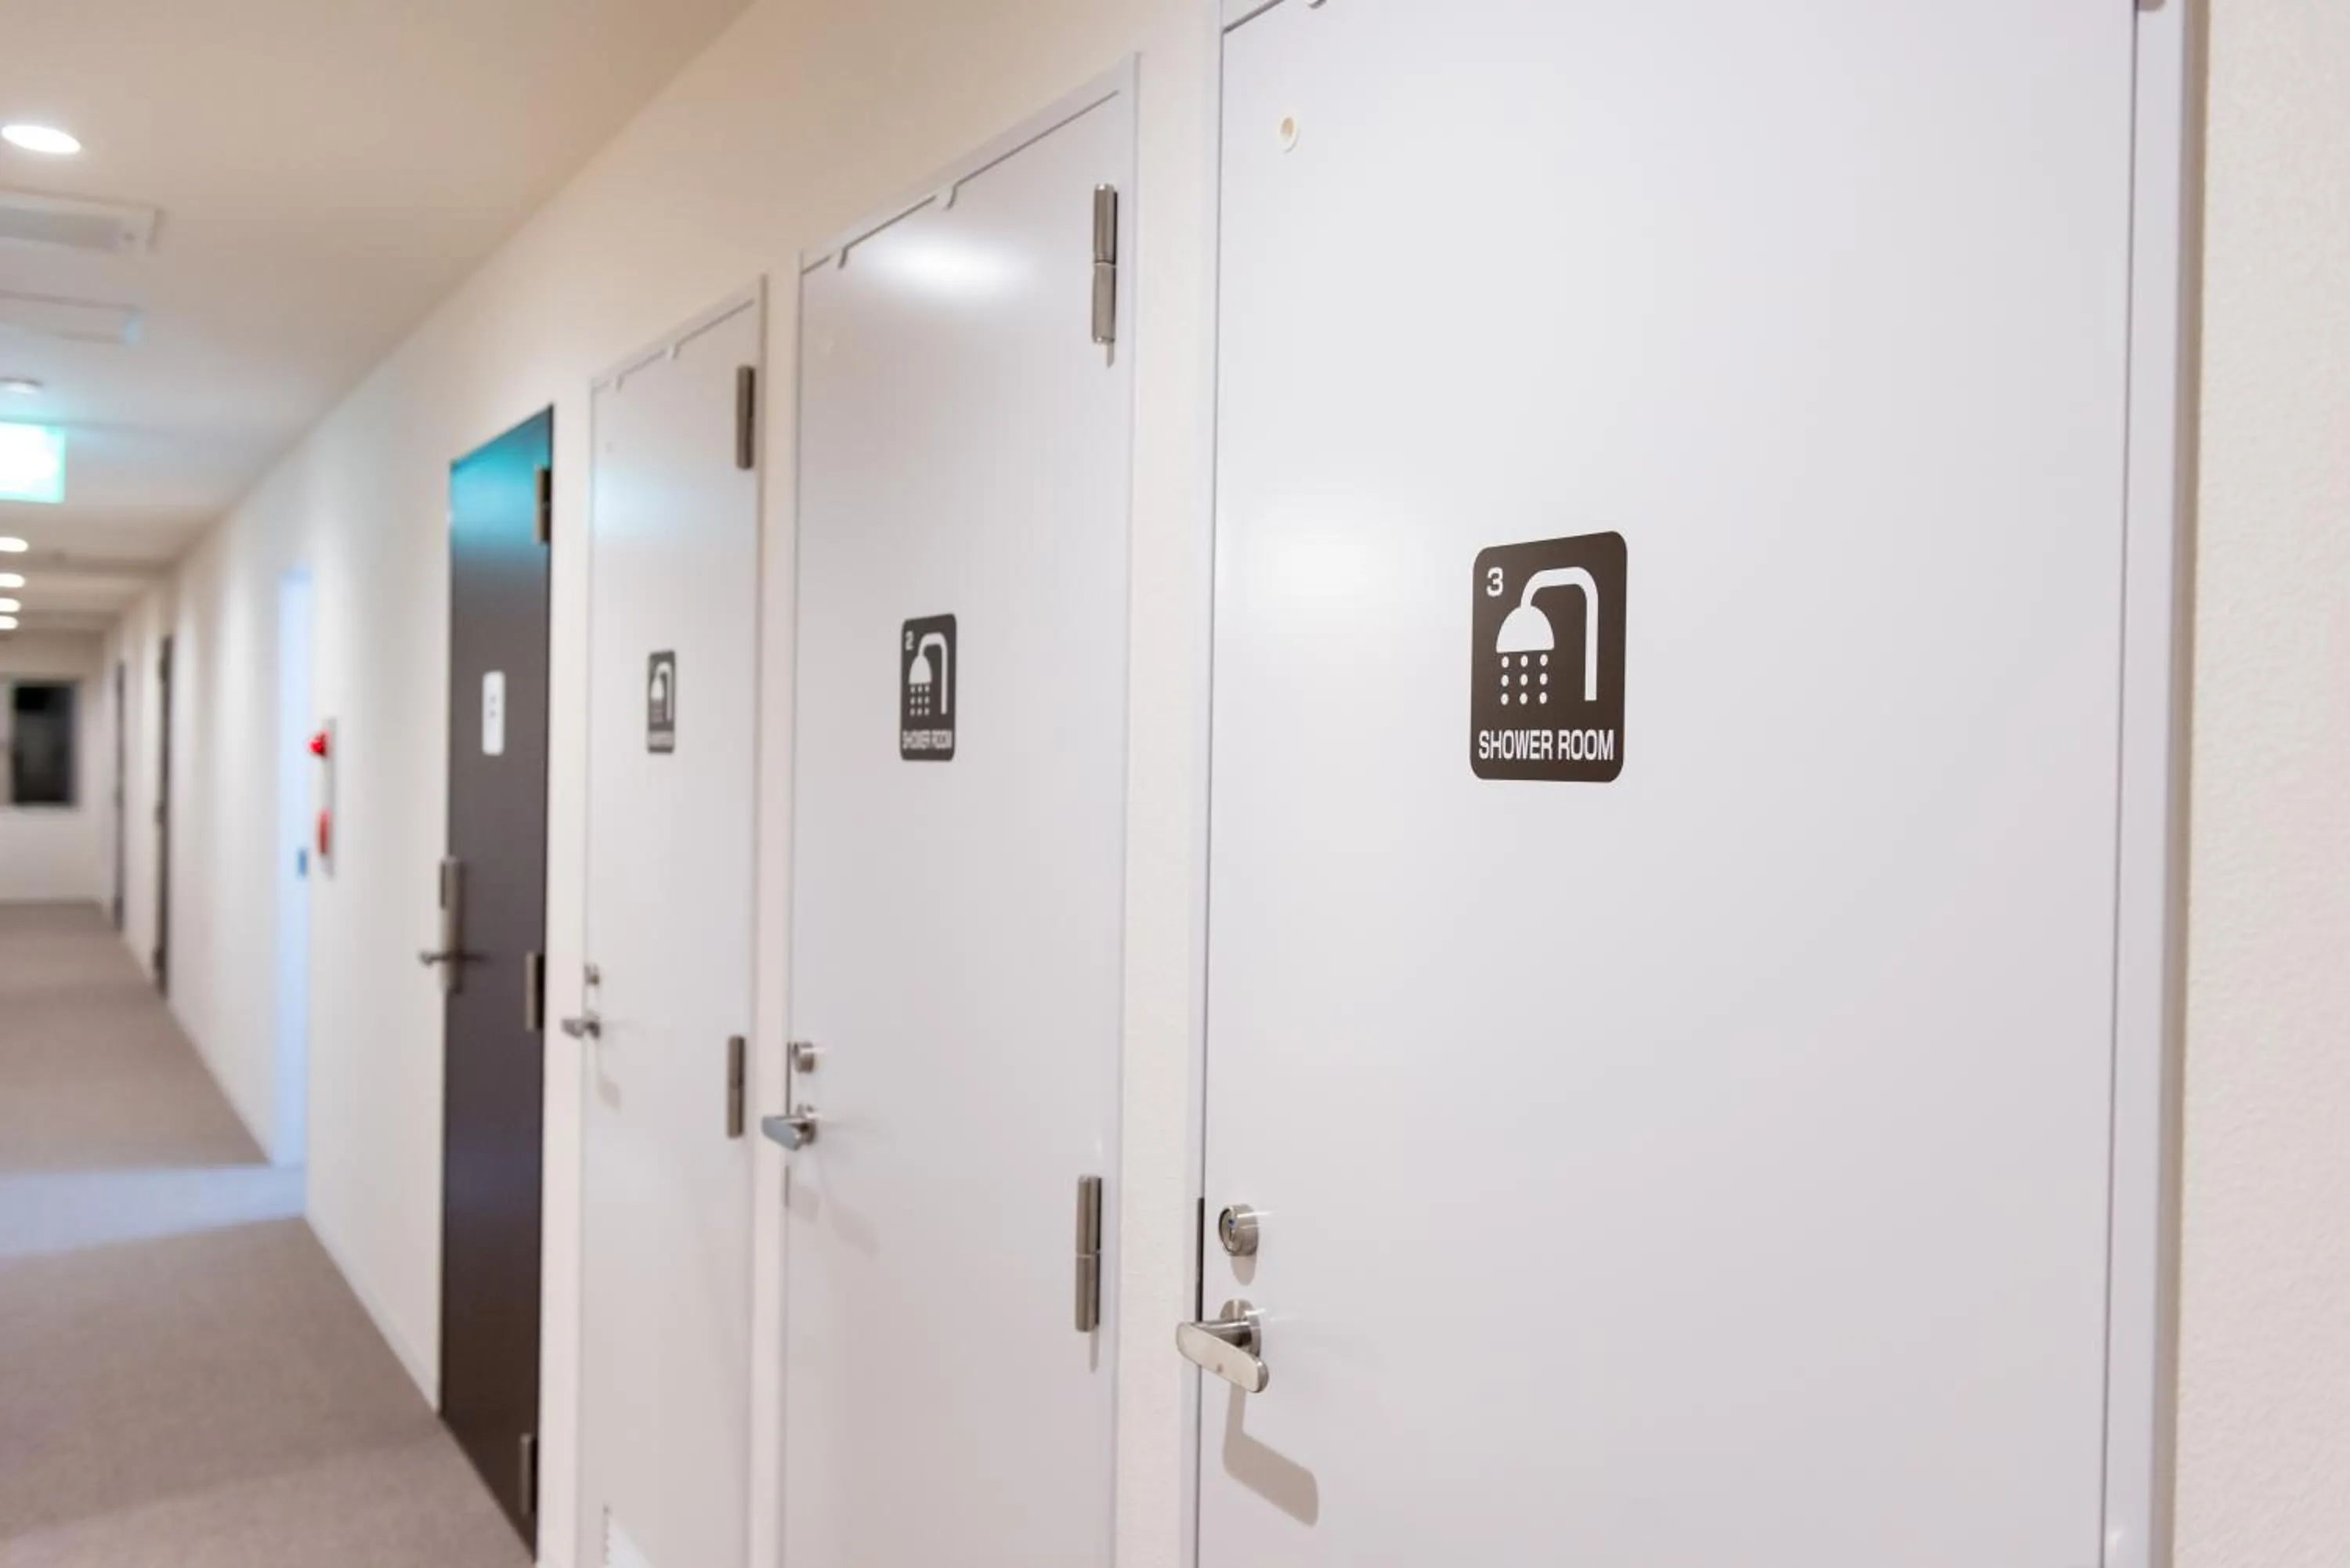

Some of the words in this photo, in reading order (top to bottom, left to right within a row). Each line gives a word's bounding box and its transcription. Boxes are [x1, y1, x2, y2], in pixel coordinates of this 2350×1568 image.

[1487, 567, 1503, 596] 3
[905, 630, 913, 651] 2
[1478, 729, 1553, 761] SHOWER
[1558, 729, 1614, 761] ROOM
